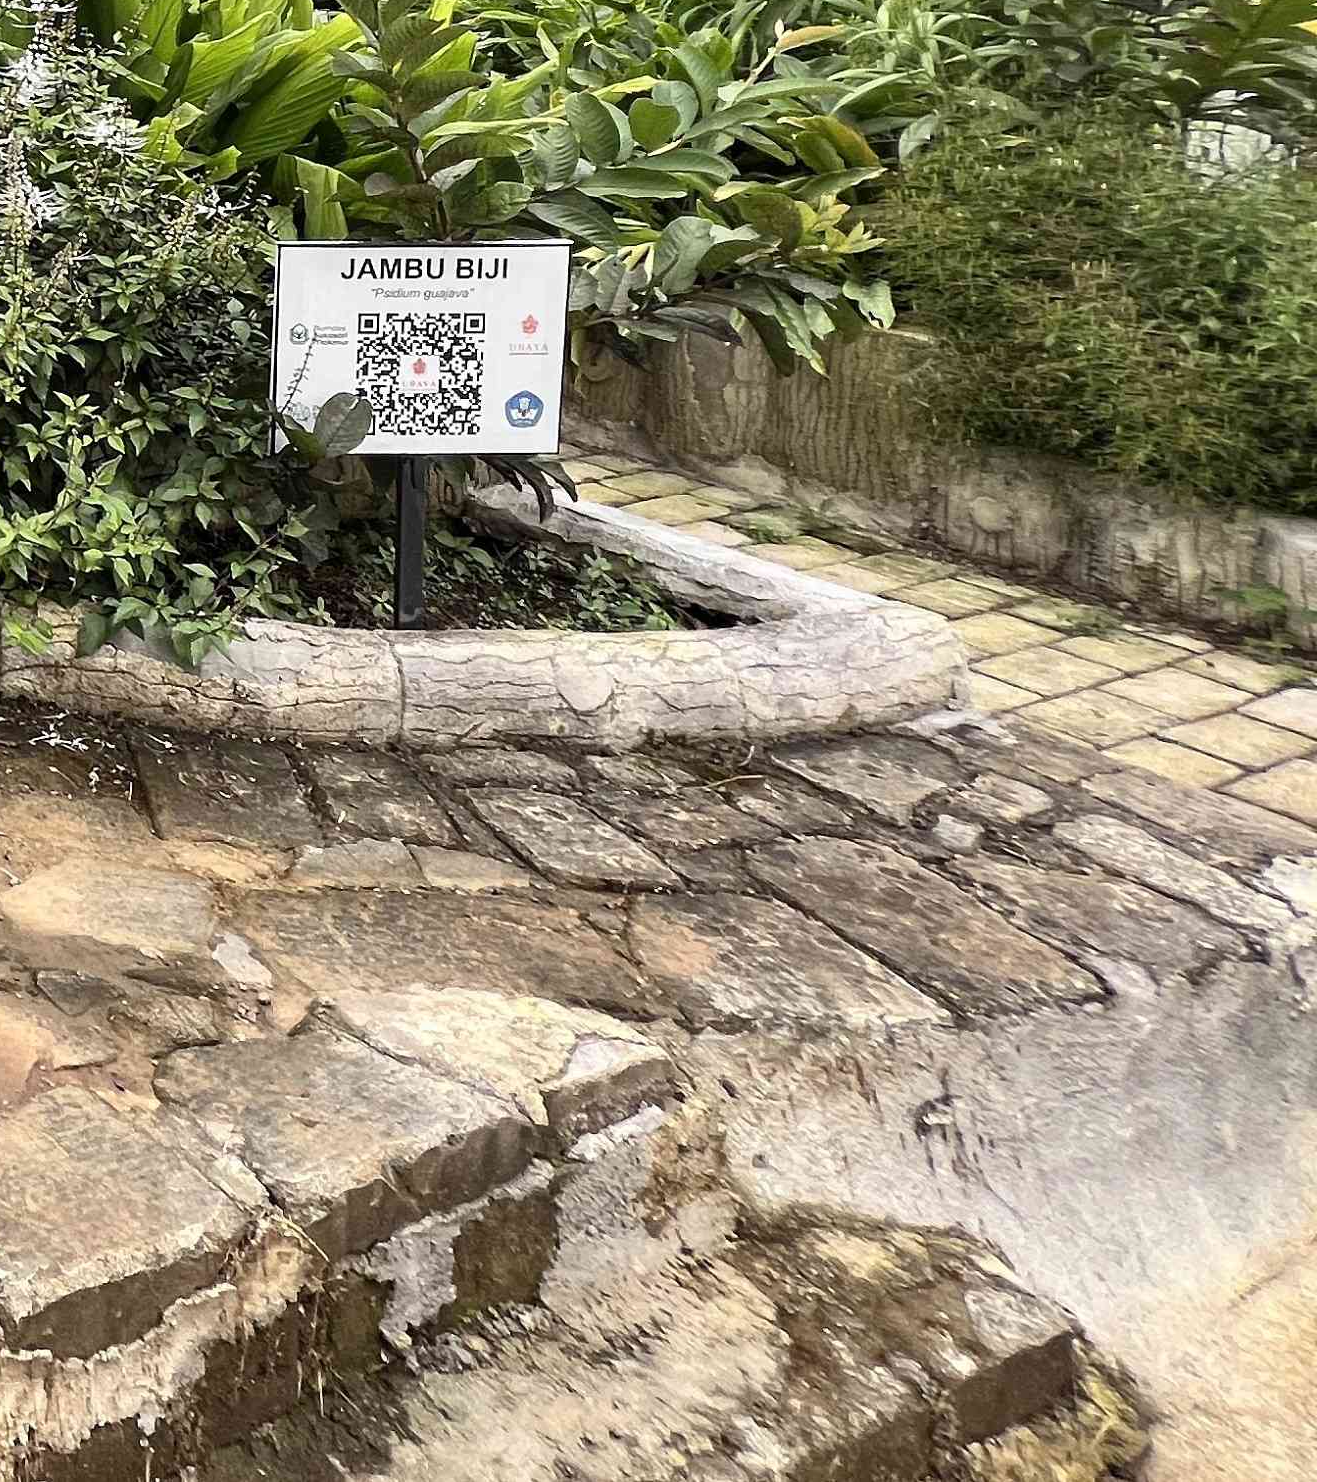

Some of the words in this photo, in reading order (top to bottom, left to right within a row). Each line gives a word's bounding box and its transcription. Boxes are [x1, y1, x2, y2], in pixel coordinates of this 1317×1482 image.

[341, 258, 445, 280] JAMBU
[456, 258, 508, 280] BIJI
[371, 287, 421, 299] "Psidium
[423, 288, 475, 301] guajava"
